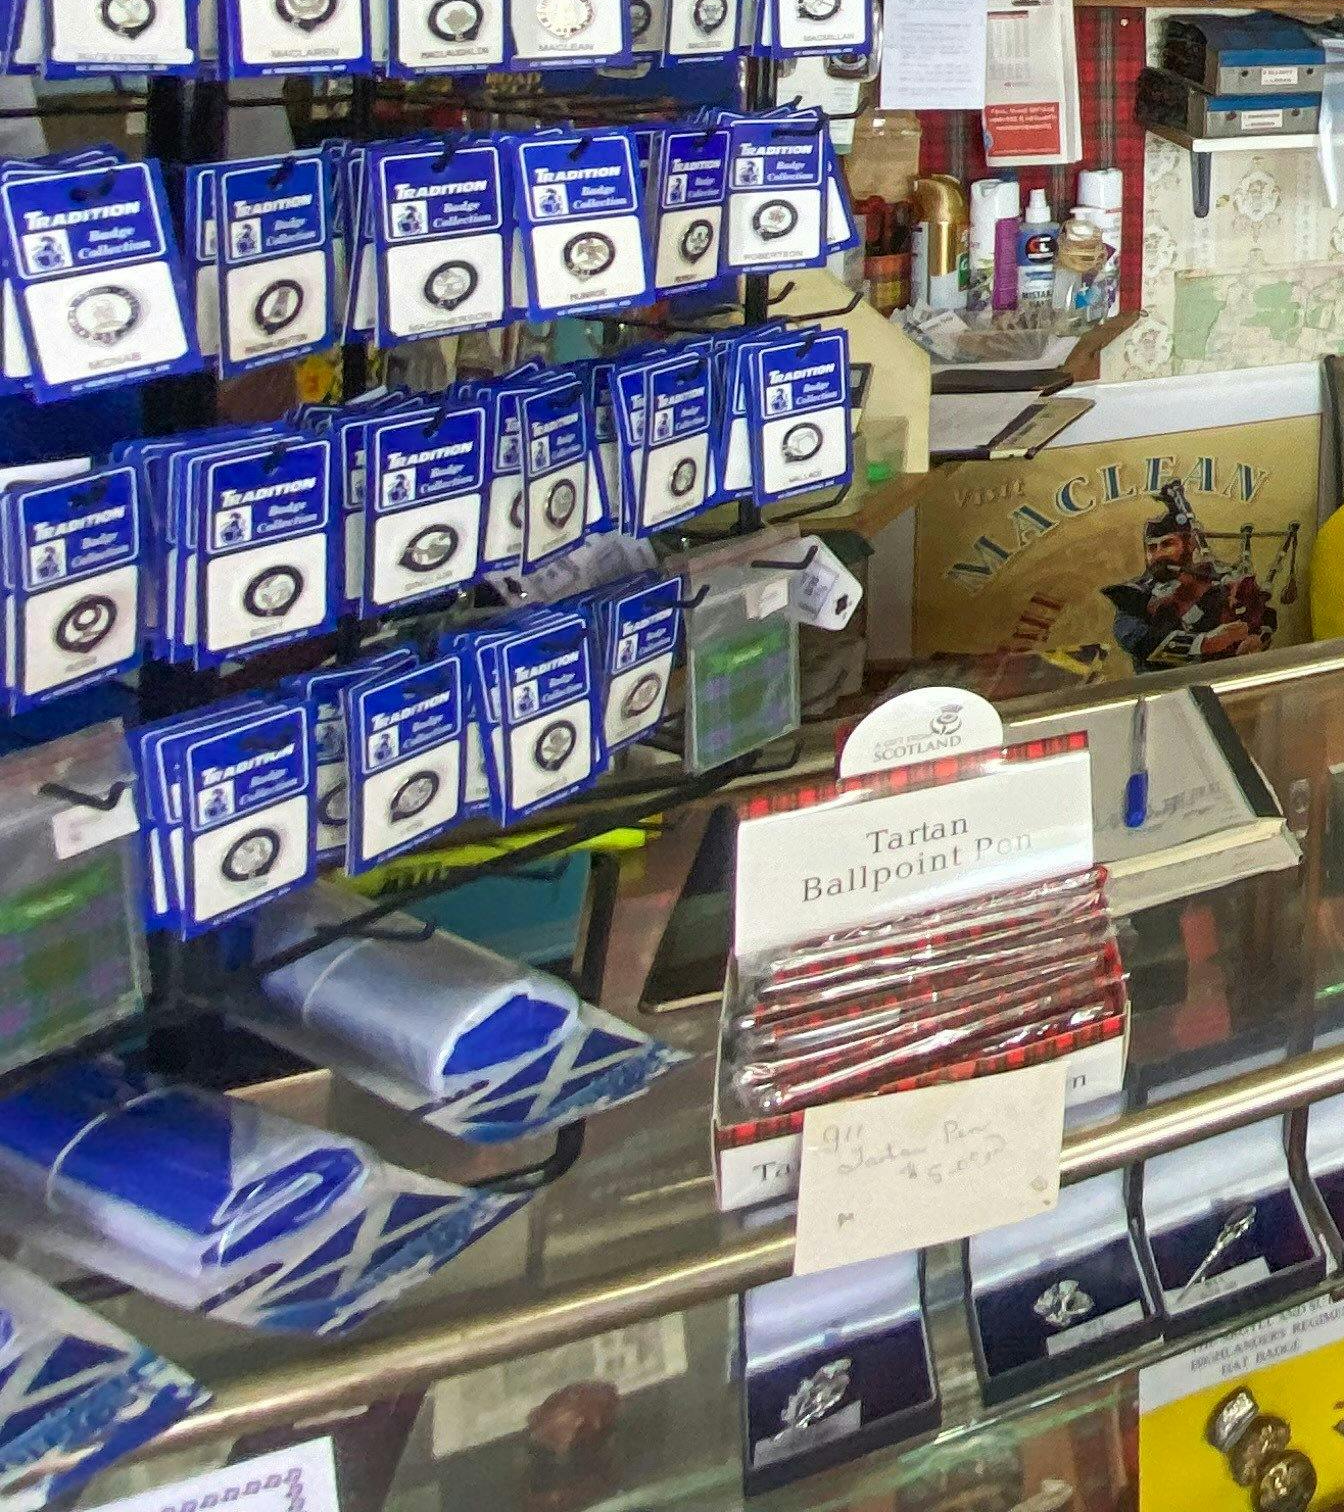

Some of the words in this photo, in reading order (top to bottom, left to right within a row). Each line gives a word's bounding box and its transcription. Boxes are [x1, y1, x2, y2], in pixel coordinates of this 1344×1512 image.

[739, 142, 814, 156] TRADITION
[534, 166, 622, 184] TRADITION
[394, 180, 488, 200] TRADITION
[23, 201, 141, 230] TRADITION
[232, 194, 313, 218] TRADITION
[769, 363, 835, 384] TRADITION
[387, 441, 474, 469] TRADITION
[947, 455, 1272, 590] MACLEAN
[874, 735, 961, 762] SCOTLAND
[866, 817, 968, 854] Tartan
[802, 846, 962, 902] Ballpoint
[975, 832, 1033, 862] Pen
